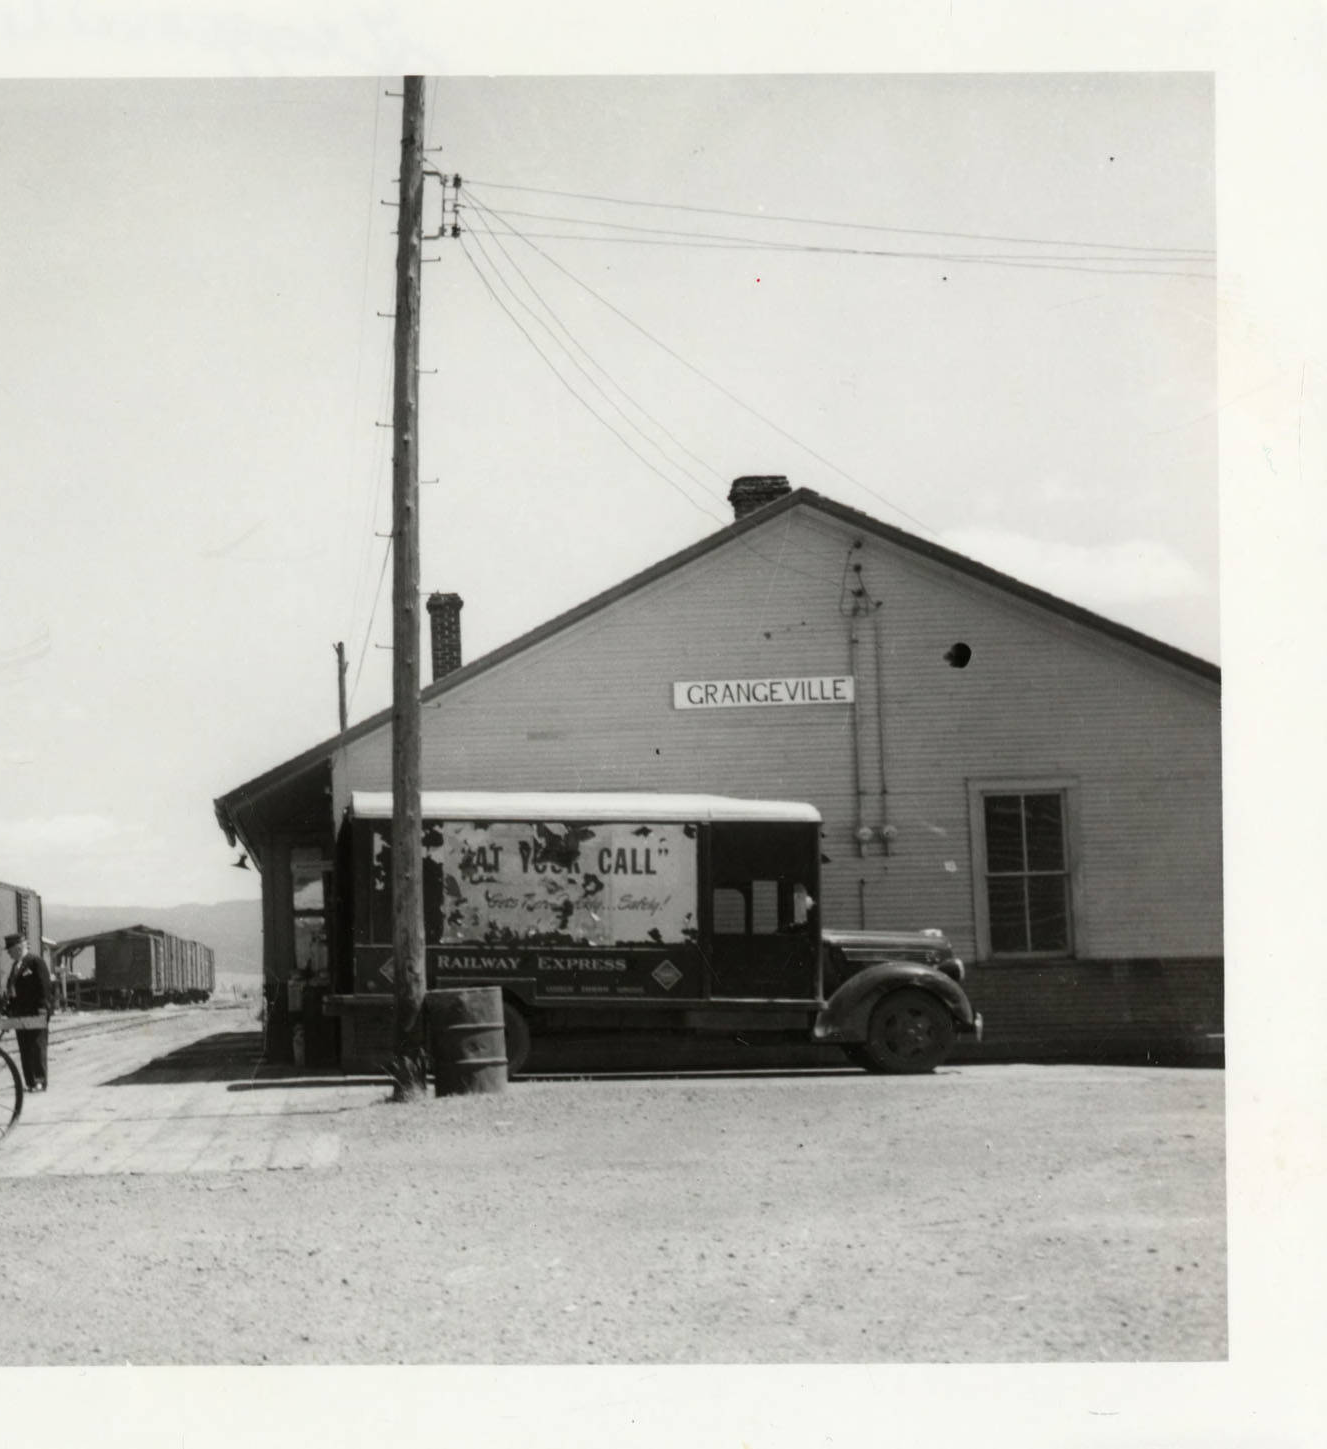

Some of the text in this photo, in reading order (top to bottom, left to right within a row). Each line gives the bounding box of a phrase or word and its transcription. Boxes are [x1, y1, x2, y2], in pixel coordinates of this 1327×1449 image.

[687, 679, 846, 704] GRANGEVILLE
[437, 955, 627, 971] RAILWAY EXPRESS
